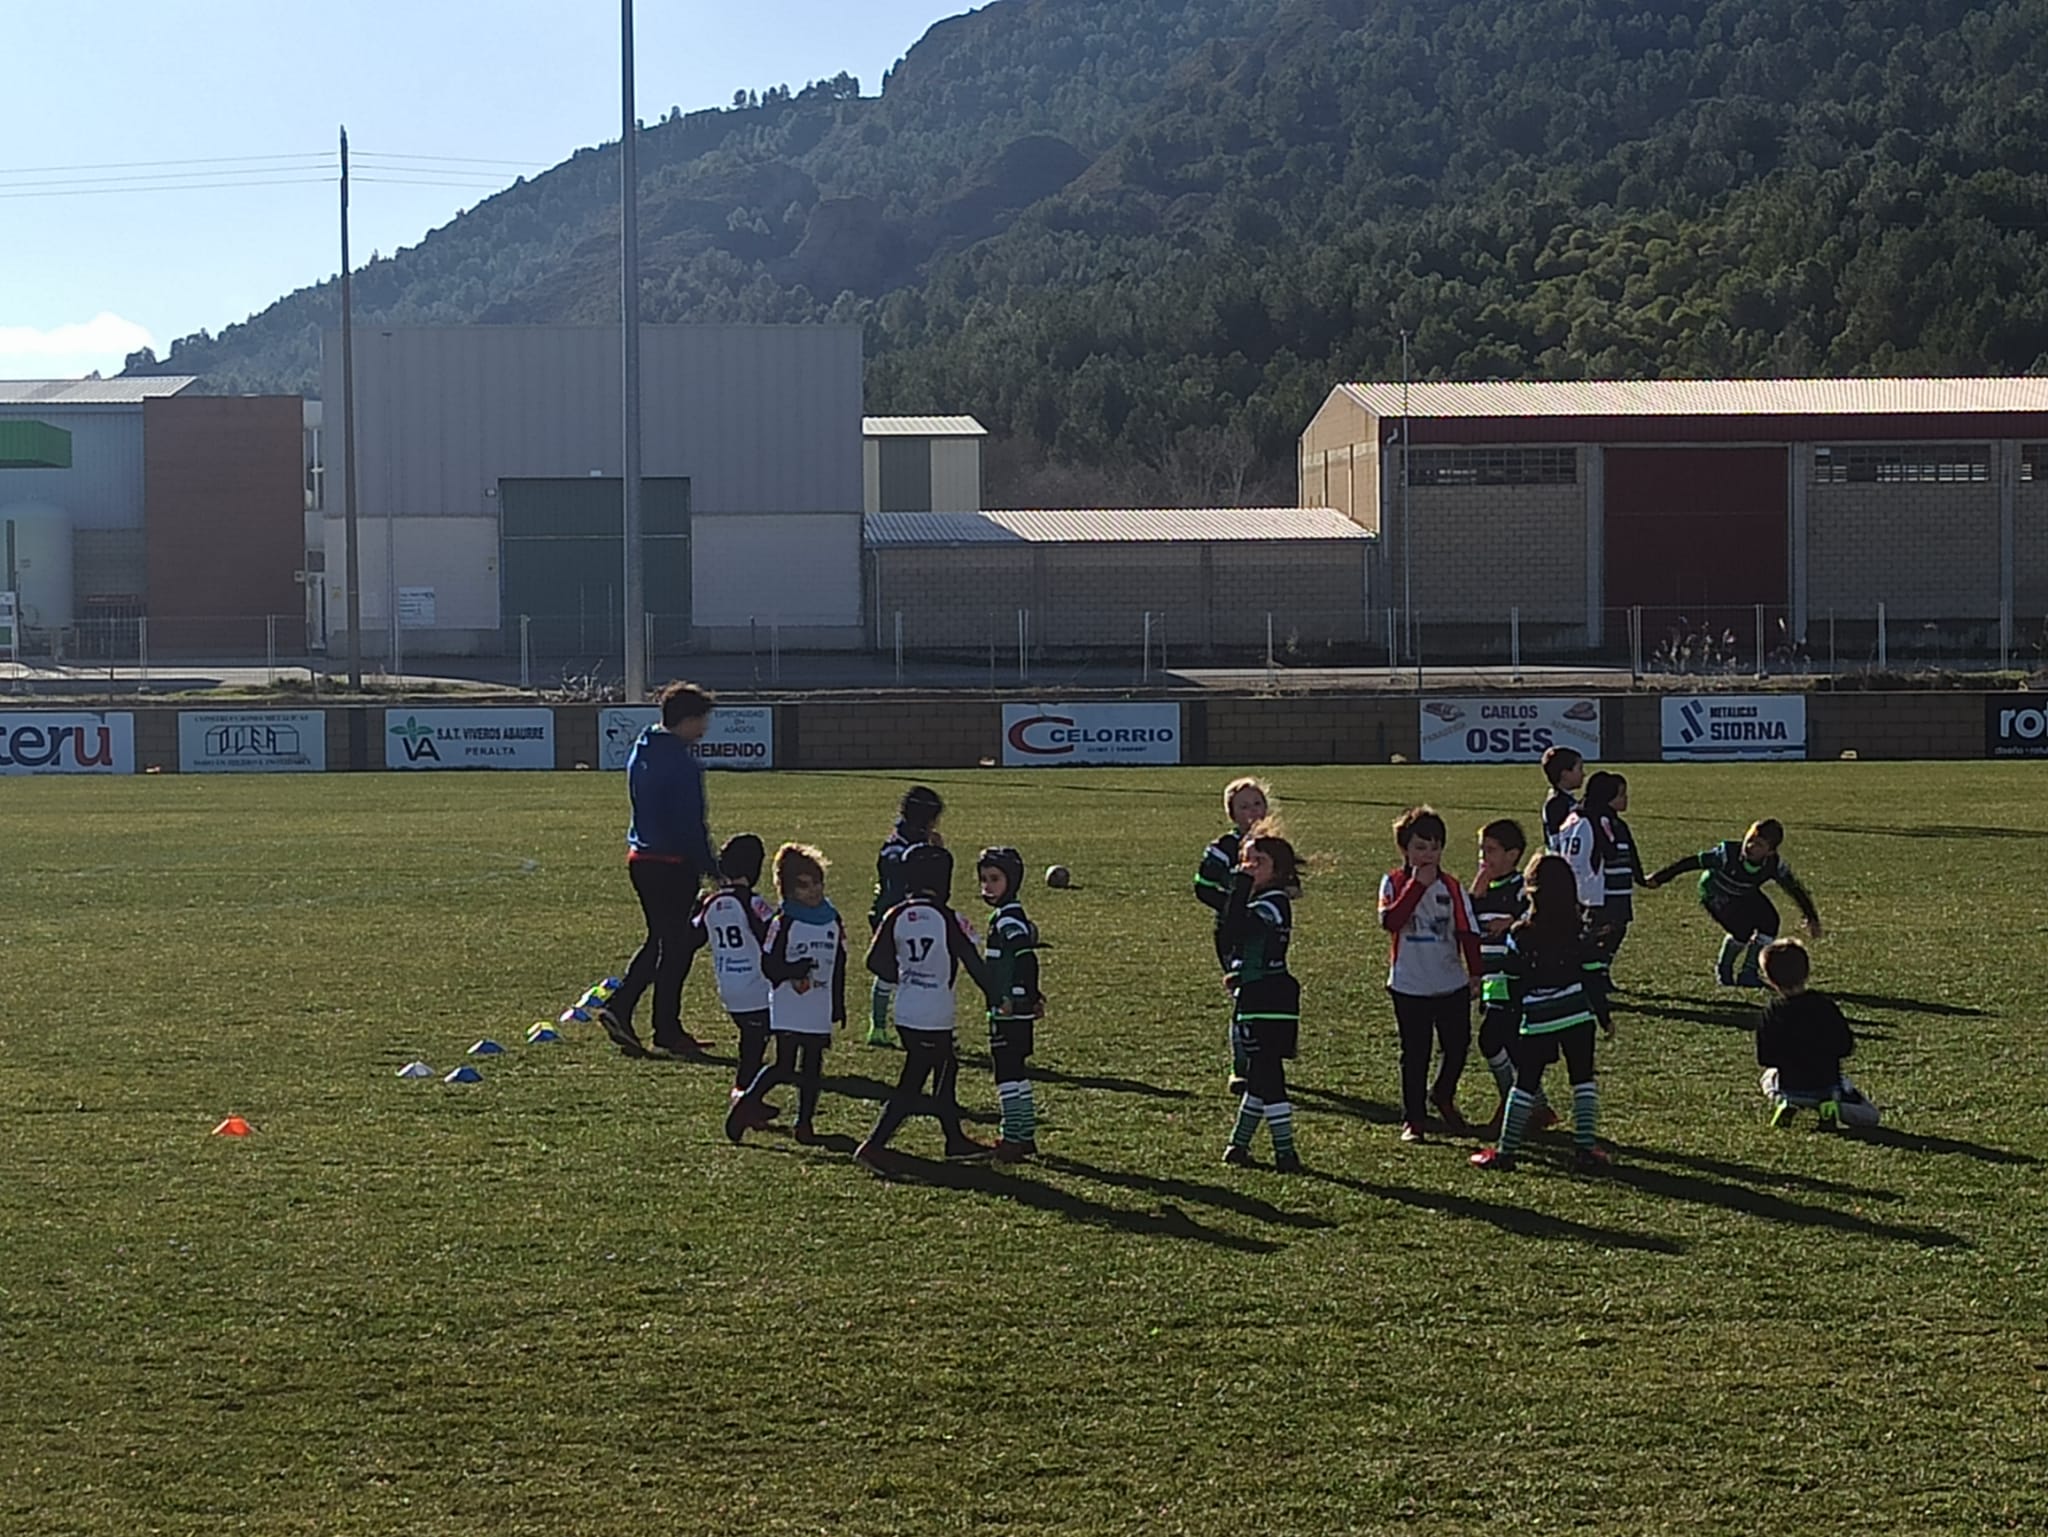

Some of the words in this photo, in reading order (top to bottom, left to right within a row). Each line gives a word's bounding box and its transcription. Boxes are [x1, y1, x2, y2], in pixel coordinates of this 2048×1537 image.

[1481, 705, 1538, 719] CARLOS
[2000, 700, 2048, 738] ro
[463, 727, 501, 740] VIVEROS
[1050, 729, 1173, 743] CELORRIO
[1466, 723, 1554, 754] OSÉS
[1710, 721, 1788, 741] SIORNA
[465, 747, 516, 756] PERALTA
[690, 743, 766, 757] REMENDO
[715, 926, 744, 949] 18
[905, 937, 935, 962] 17
